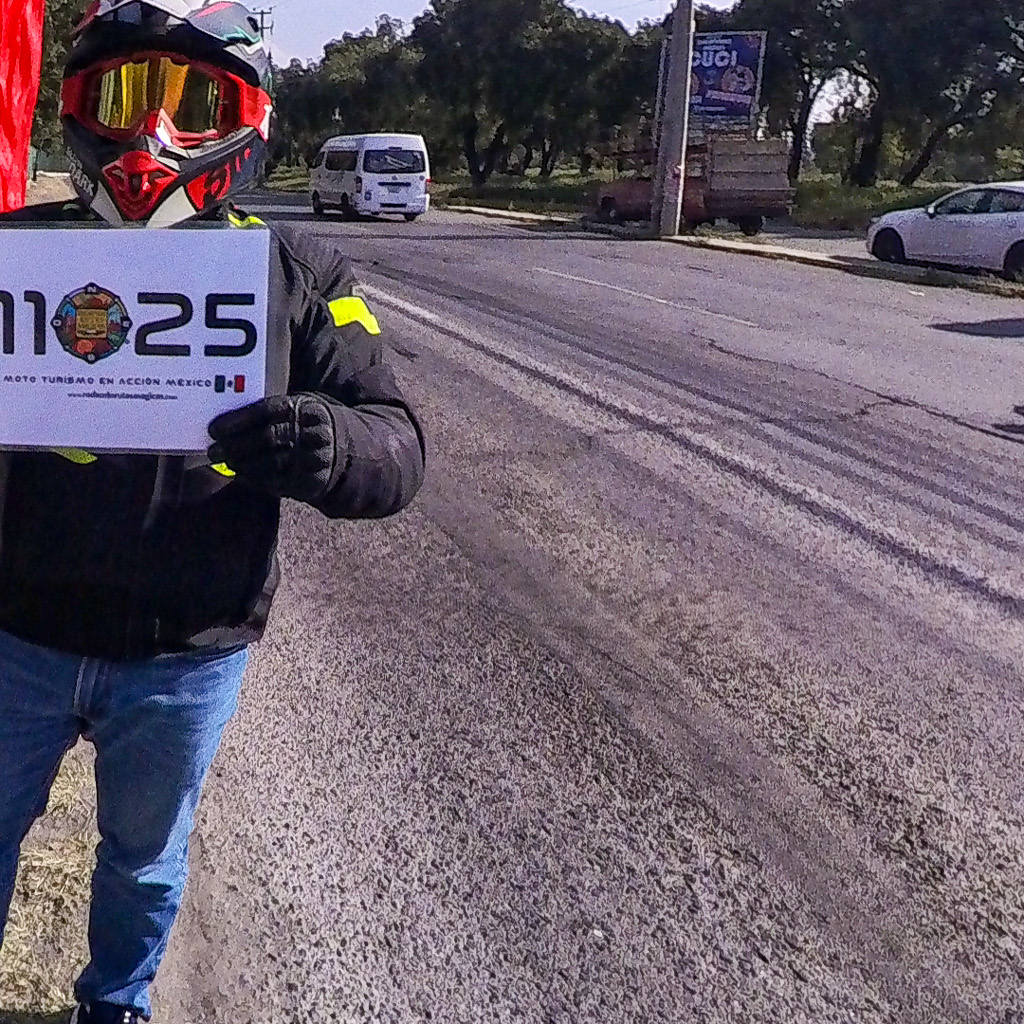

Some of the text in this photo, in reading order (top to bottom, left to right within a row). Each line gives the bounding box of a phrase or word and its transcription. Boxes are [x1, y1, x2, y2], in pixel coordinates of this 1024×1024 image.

[3, 375, 37, 384] MOTO
[41, 375, 95, 385] TURISMO
[99, 376, 115, 385] EN
